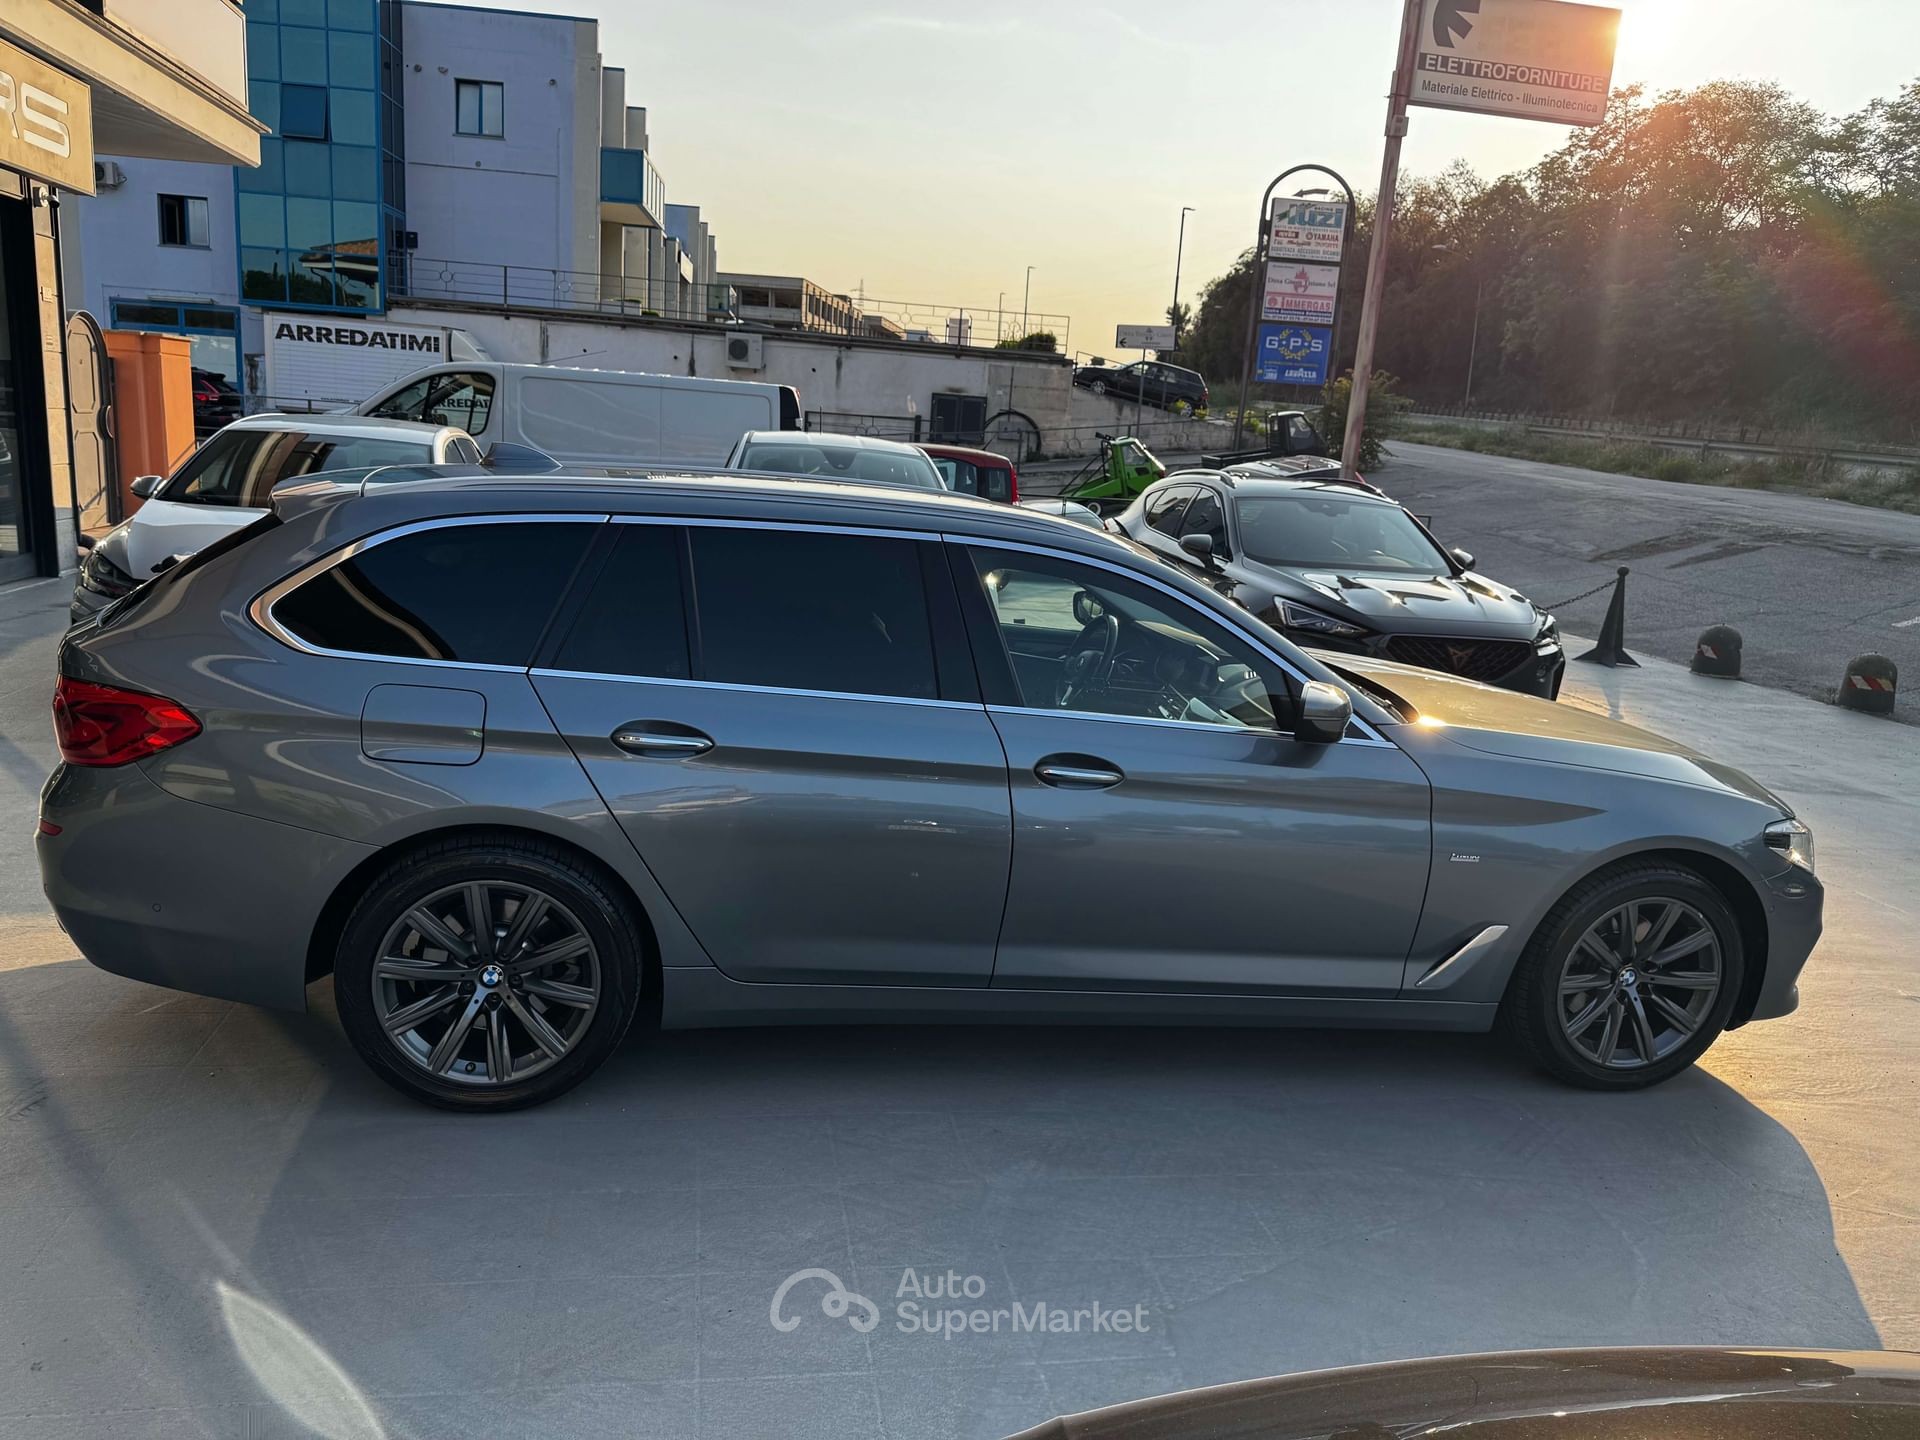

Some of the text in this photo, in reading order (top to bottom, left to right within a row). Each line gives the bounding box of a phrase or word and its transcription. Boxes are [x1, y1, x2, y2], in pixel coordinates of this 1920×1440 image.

[1425, 54, 1604, 92] ELETTROFORNITURE
[1422, 79, 1468, 97] Materiale
[1471, 86, 1514, 102] Elettrico
[1523, 93, 1598, 113] Illuminotecnica
[1314, 233, 1339, 242] YAMAHA
[1280, 296, 1331, 311] IMMERGAS
[275, 323, 440, 353] ARREDATIMI
